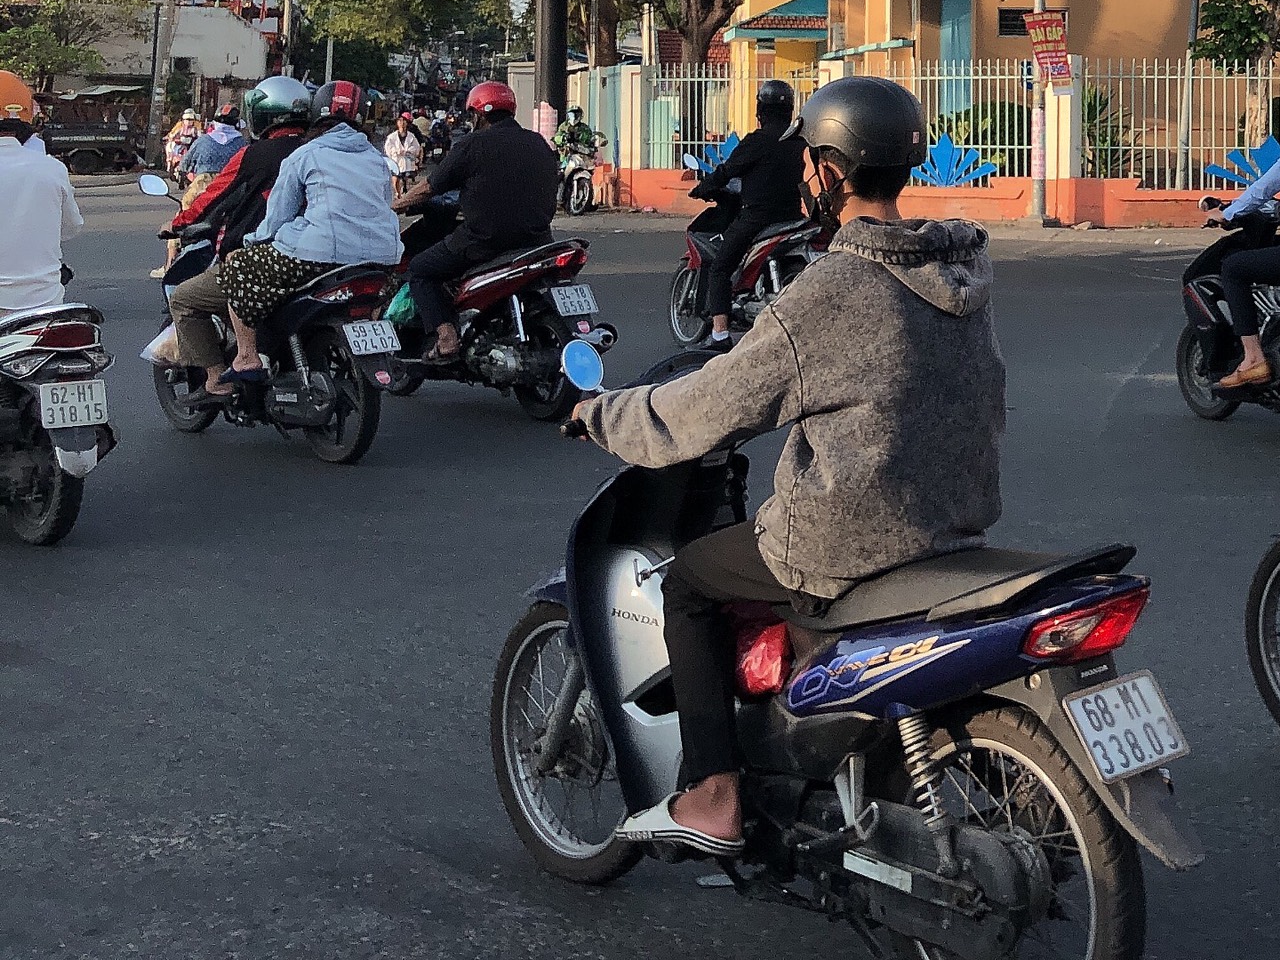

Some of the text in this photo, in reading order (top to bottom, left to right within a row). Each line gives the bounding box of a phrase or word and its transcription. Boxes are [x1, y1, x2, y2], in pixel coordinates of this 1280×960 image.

[351, 323, 386, 338] 59-E1
[50, 384, 94, 404] 62-H1
[46, 402, 104, 424] 318.15
[611, 607, 660, 627] HONDA
[1092, 716, 1179, 775] 338.03
